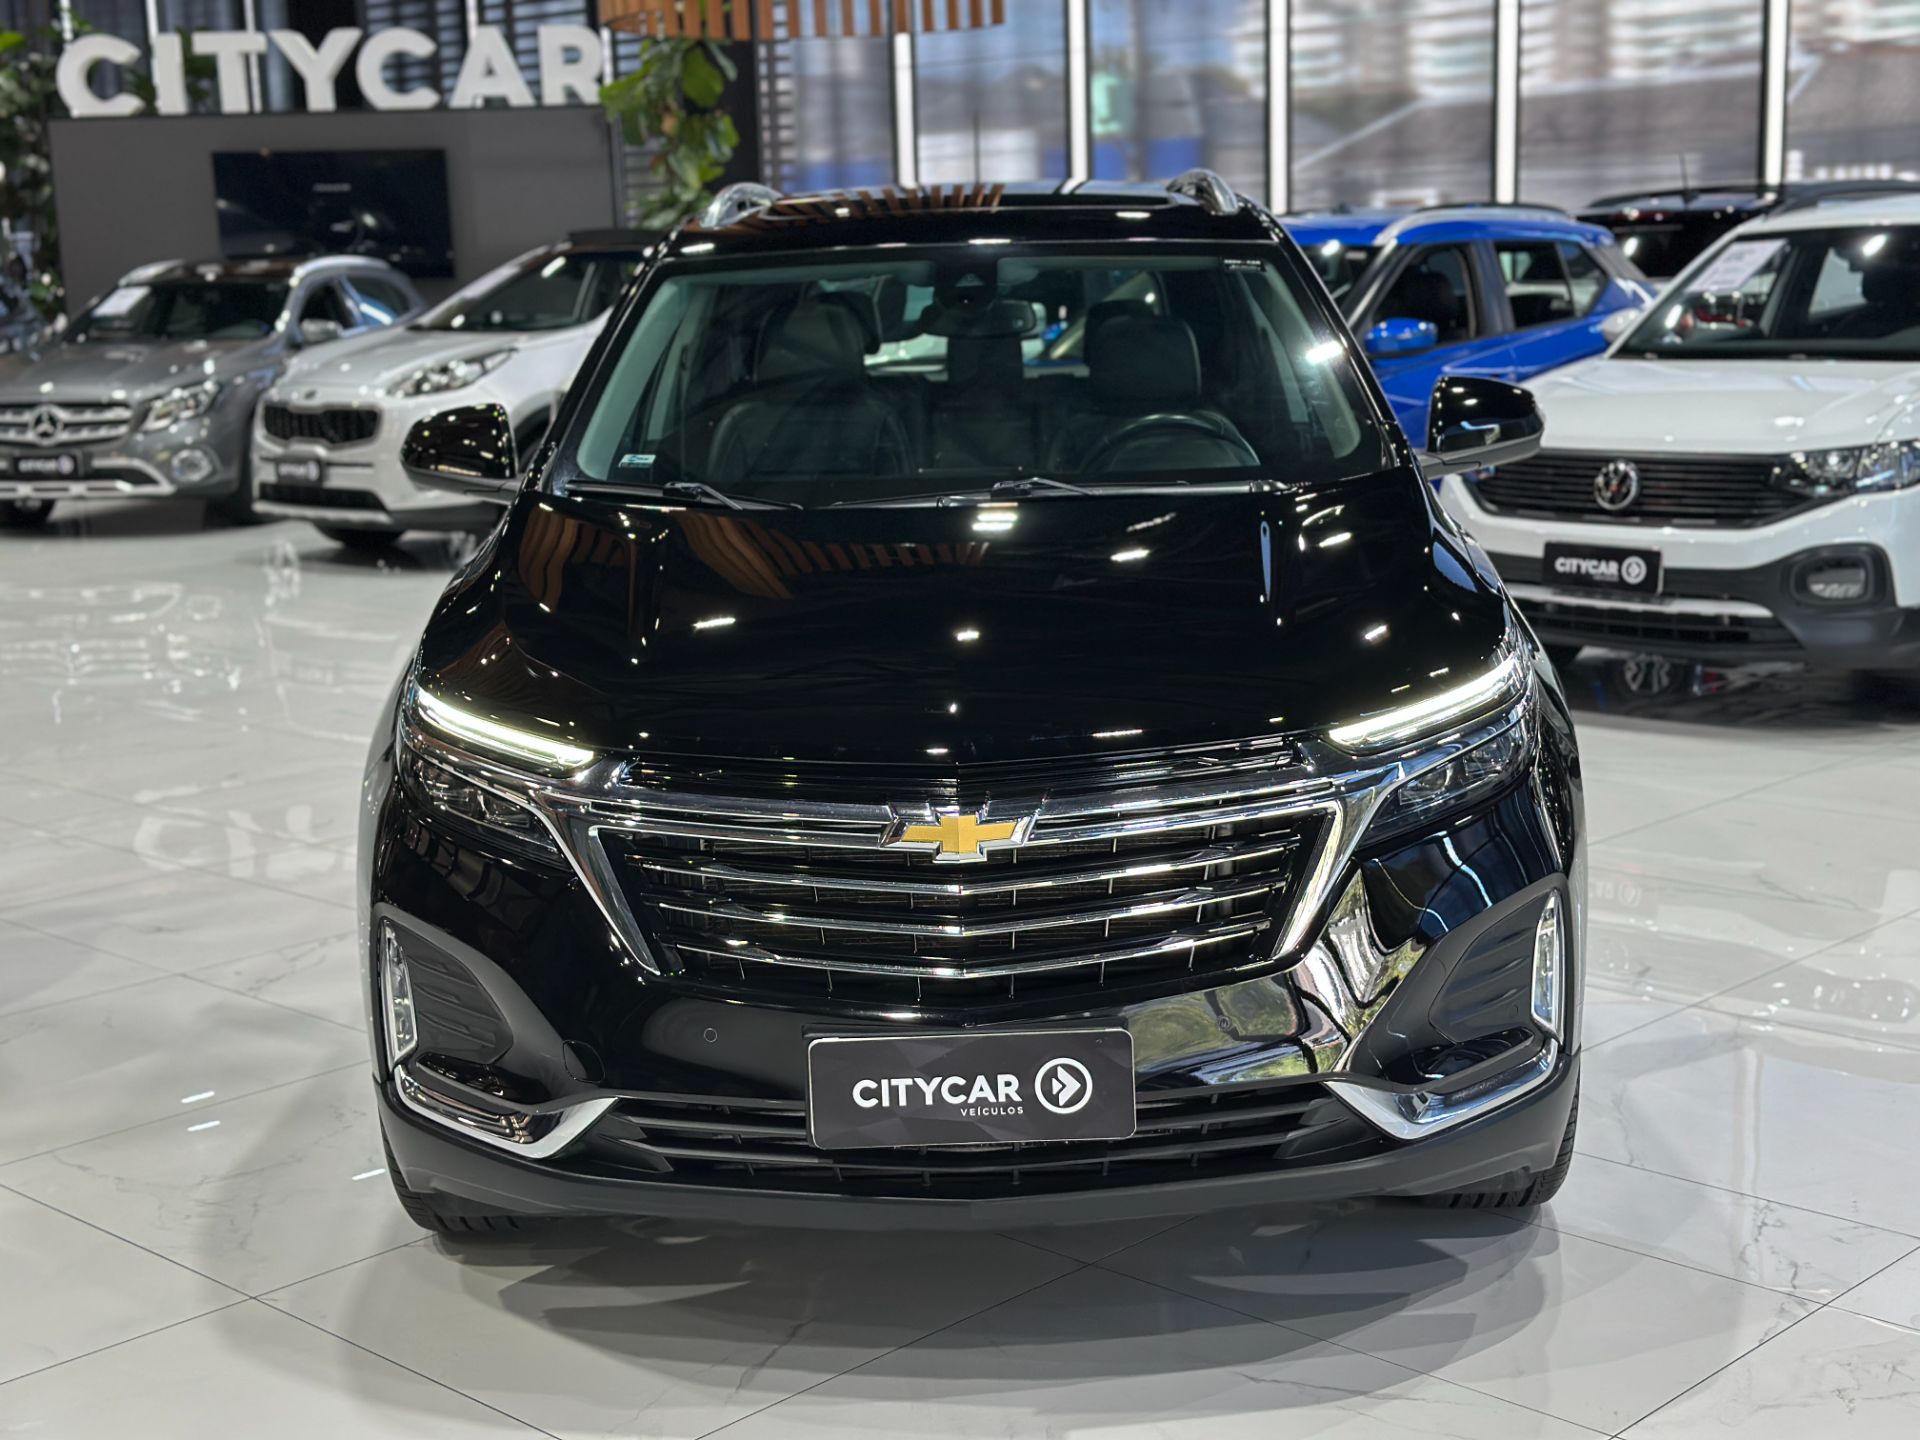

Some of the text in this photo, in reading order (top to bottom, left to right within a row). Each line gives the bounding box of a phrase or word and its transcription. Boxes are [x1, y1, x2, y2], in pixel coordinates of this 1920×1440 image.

[56, 24, 602, 117] CITYCAR
[1554, 556, 1619, 576] CITYCAR
[852, 1074, 1022, 1108] CITYCAR
[960, 1106, 1024, 1116] VEÍCULOS
